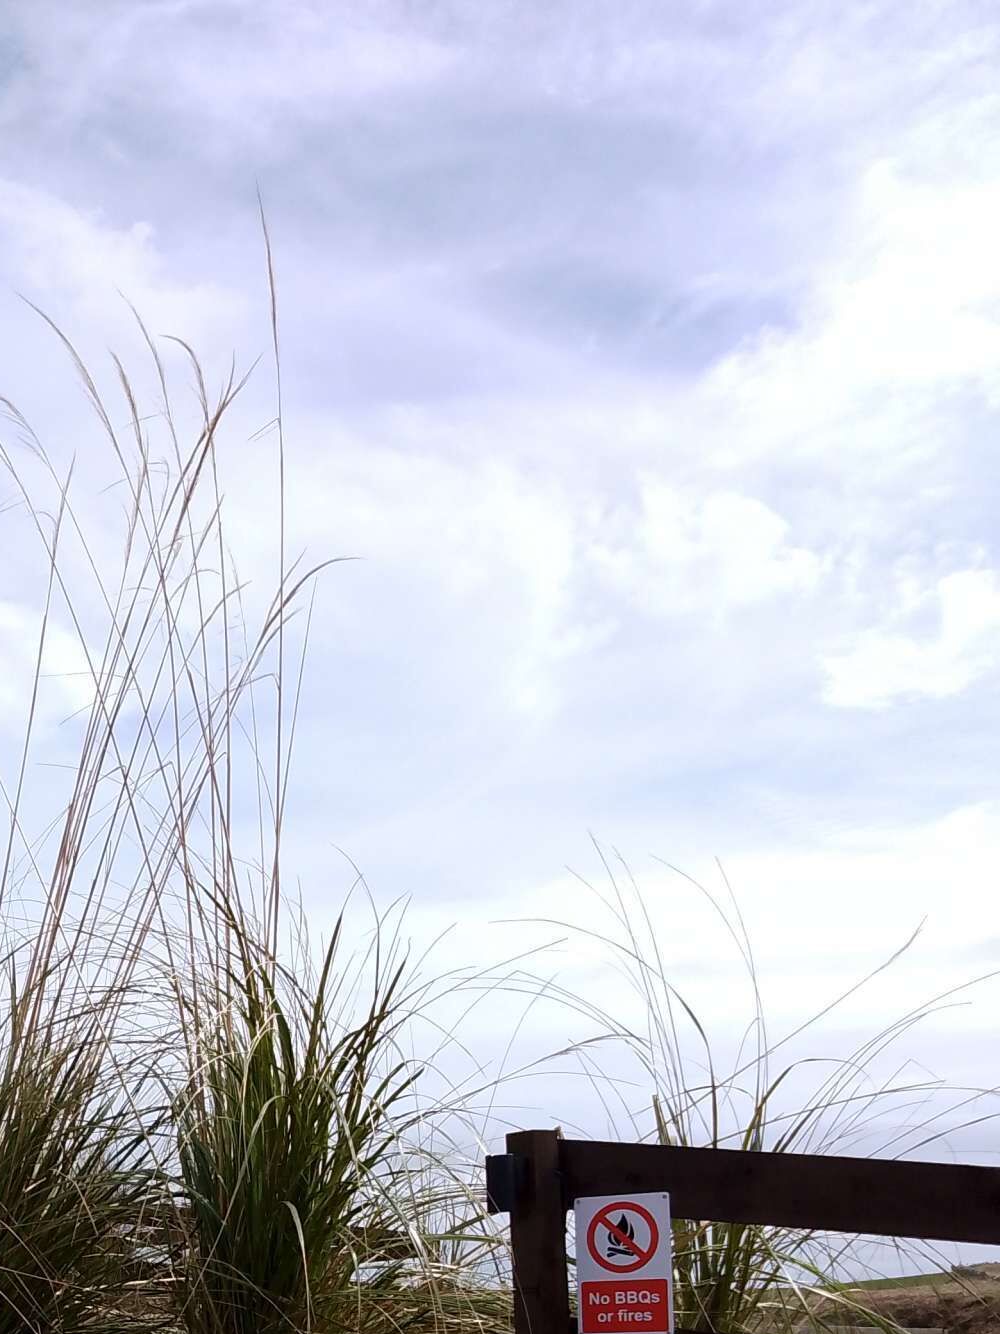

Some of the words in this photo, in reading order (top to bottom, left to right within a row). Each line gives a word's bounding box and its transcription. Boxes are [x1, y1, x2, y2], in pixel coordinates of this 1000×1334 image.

[588, 1292, 610, 1305] No
[615, 1290, 660, 1304] BBQs
[597, 1312, 614, 1322] or
[617, 1309, 653, 1322] fires
